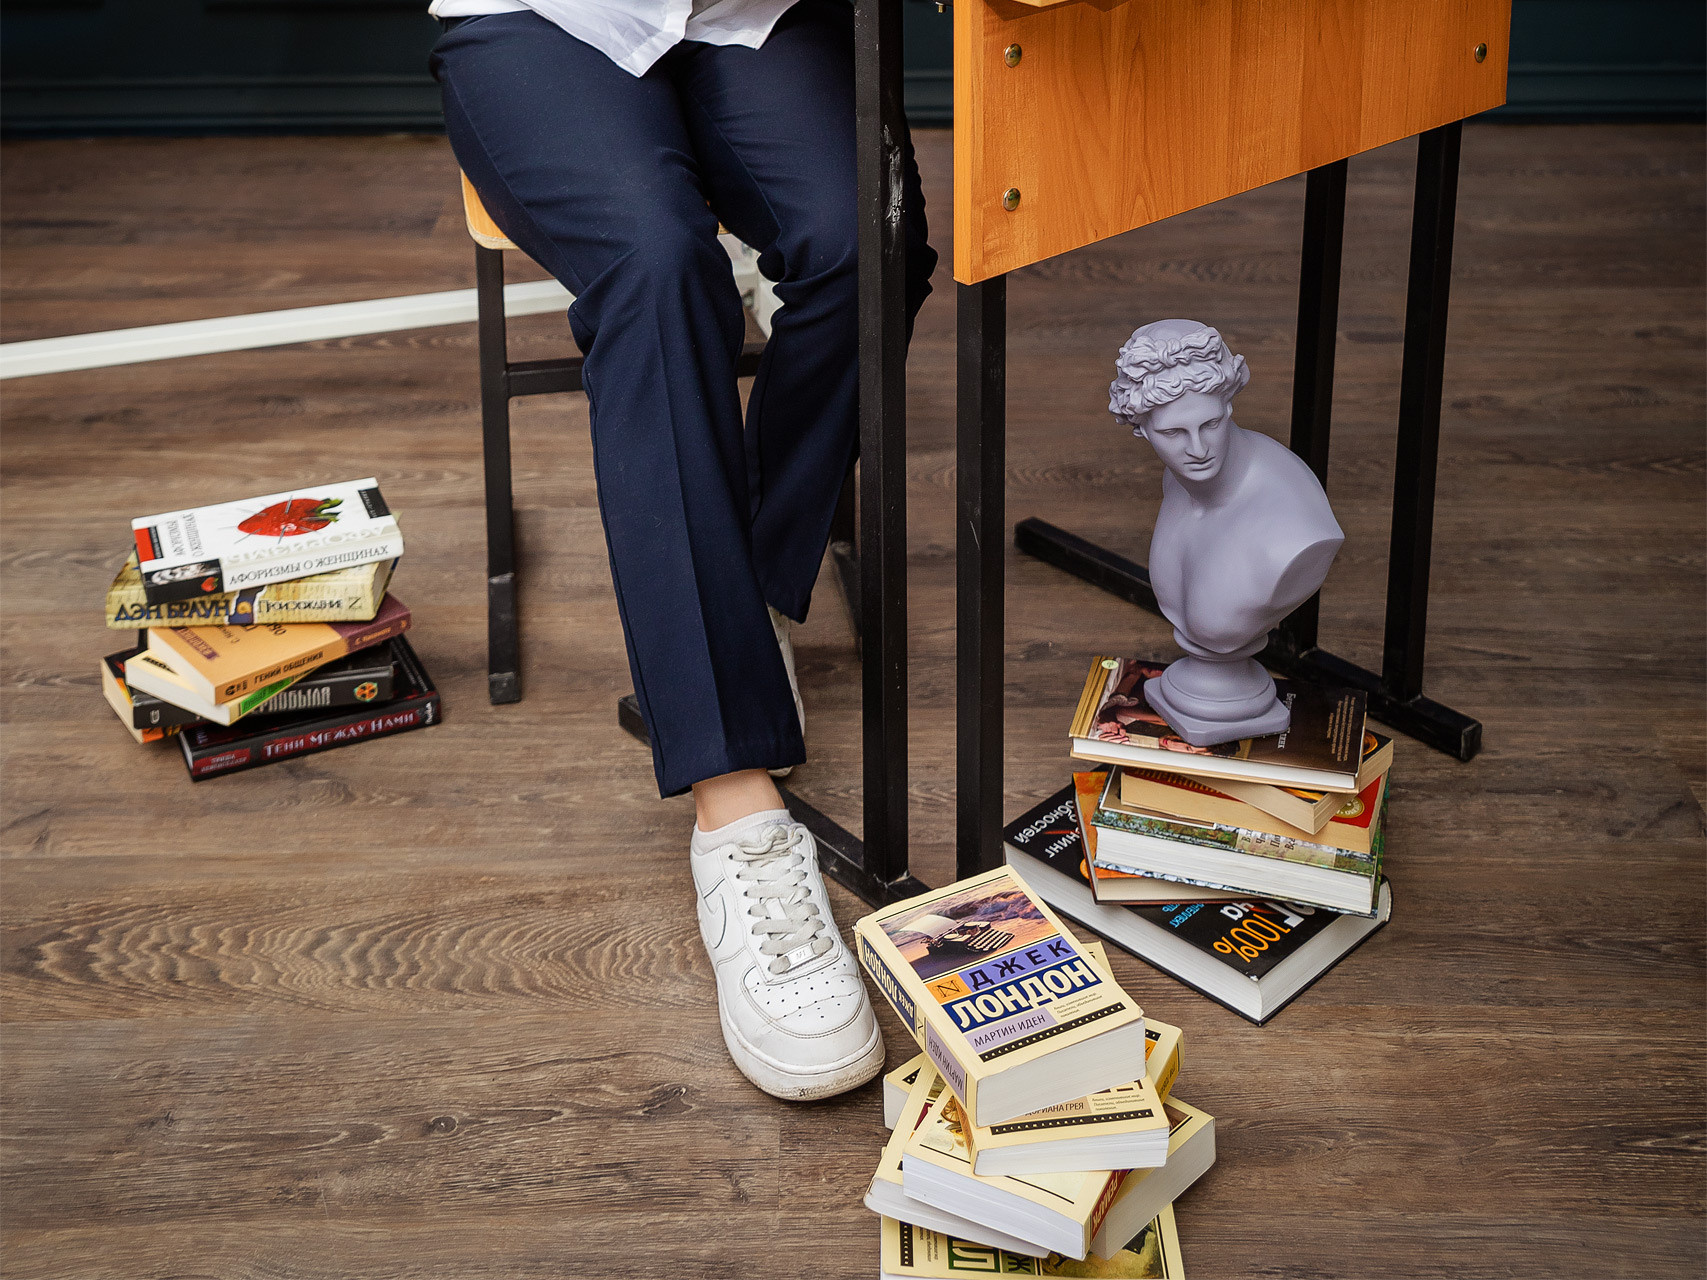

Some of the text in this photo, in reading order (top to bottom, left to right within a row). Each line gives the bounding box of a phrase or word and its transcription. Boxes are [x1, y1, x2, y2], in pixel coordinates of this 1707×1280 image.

[228, 559, 301, 586] АФОРИЗМЫ
[303, 559, 314, 570] О
[315, 544, 390, 569] ЖЕНЩИНАХ
[114, 599, 231, 622] ДЭН БРАУН
[254, 650, 324, 685] ГЕНИЙ ОБЩЕНИЯ
[256, 686, 332, 713] НОБЫЛЯ
[1212, 913, 1292, 963] 100%
[863, 943, 899, 1003] ЛОНДОН
[968, 939, 1073, 991] ДЖЕК
[951, 959, 1098, 1029] ЛОНДОН
[973, 1014, 1047, 1048] МАРТИН ИДЕН
[928, 1035, 964, 1092] МАРТИН ИДЕН
[1065, 1102, 1084, 1111] ГРЕЯ
